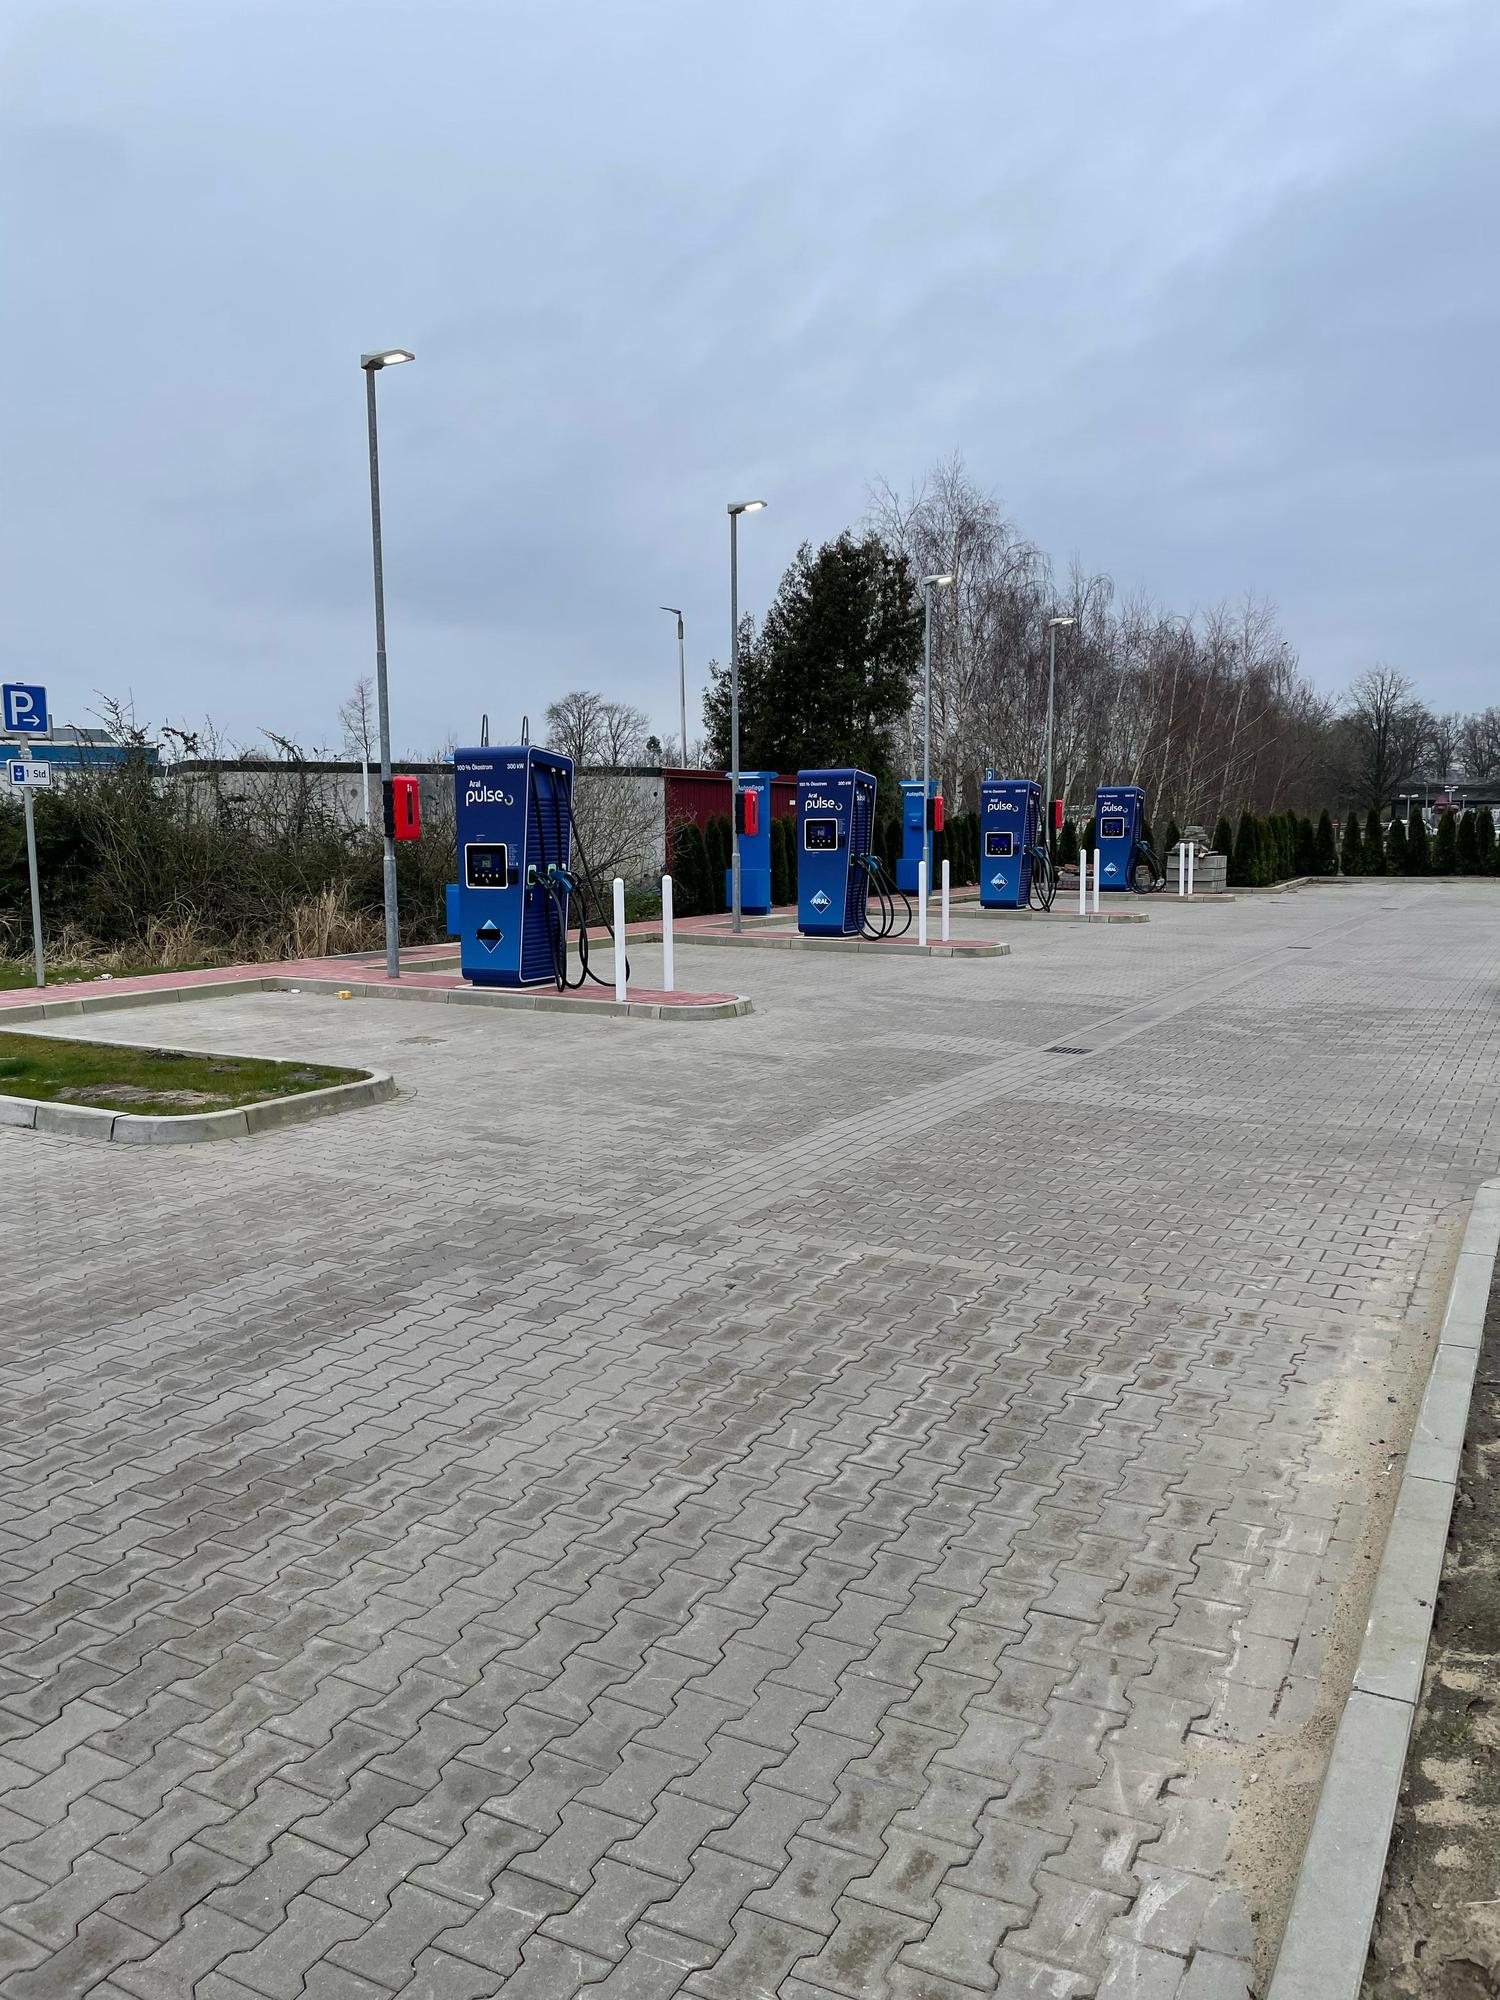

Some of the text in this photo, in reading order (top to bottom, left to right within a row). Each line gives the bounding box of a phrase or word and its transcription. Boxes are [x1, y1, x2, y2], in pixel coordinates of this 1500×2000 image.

[10, 690, 34, 725] P
[469, 780, 481, 788] Aral
[465, 785, 504, 807] pulse
[805, 796, 835, 812] pulse
[987, 801, 1013, 813] pulse
[1101, 803, 1123, 814] pulse
